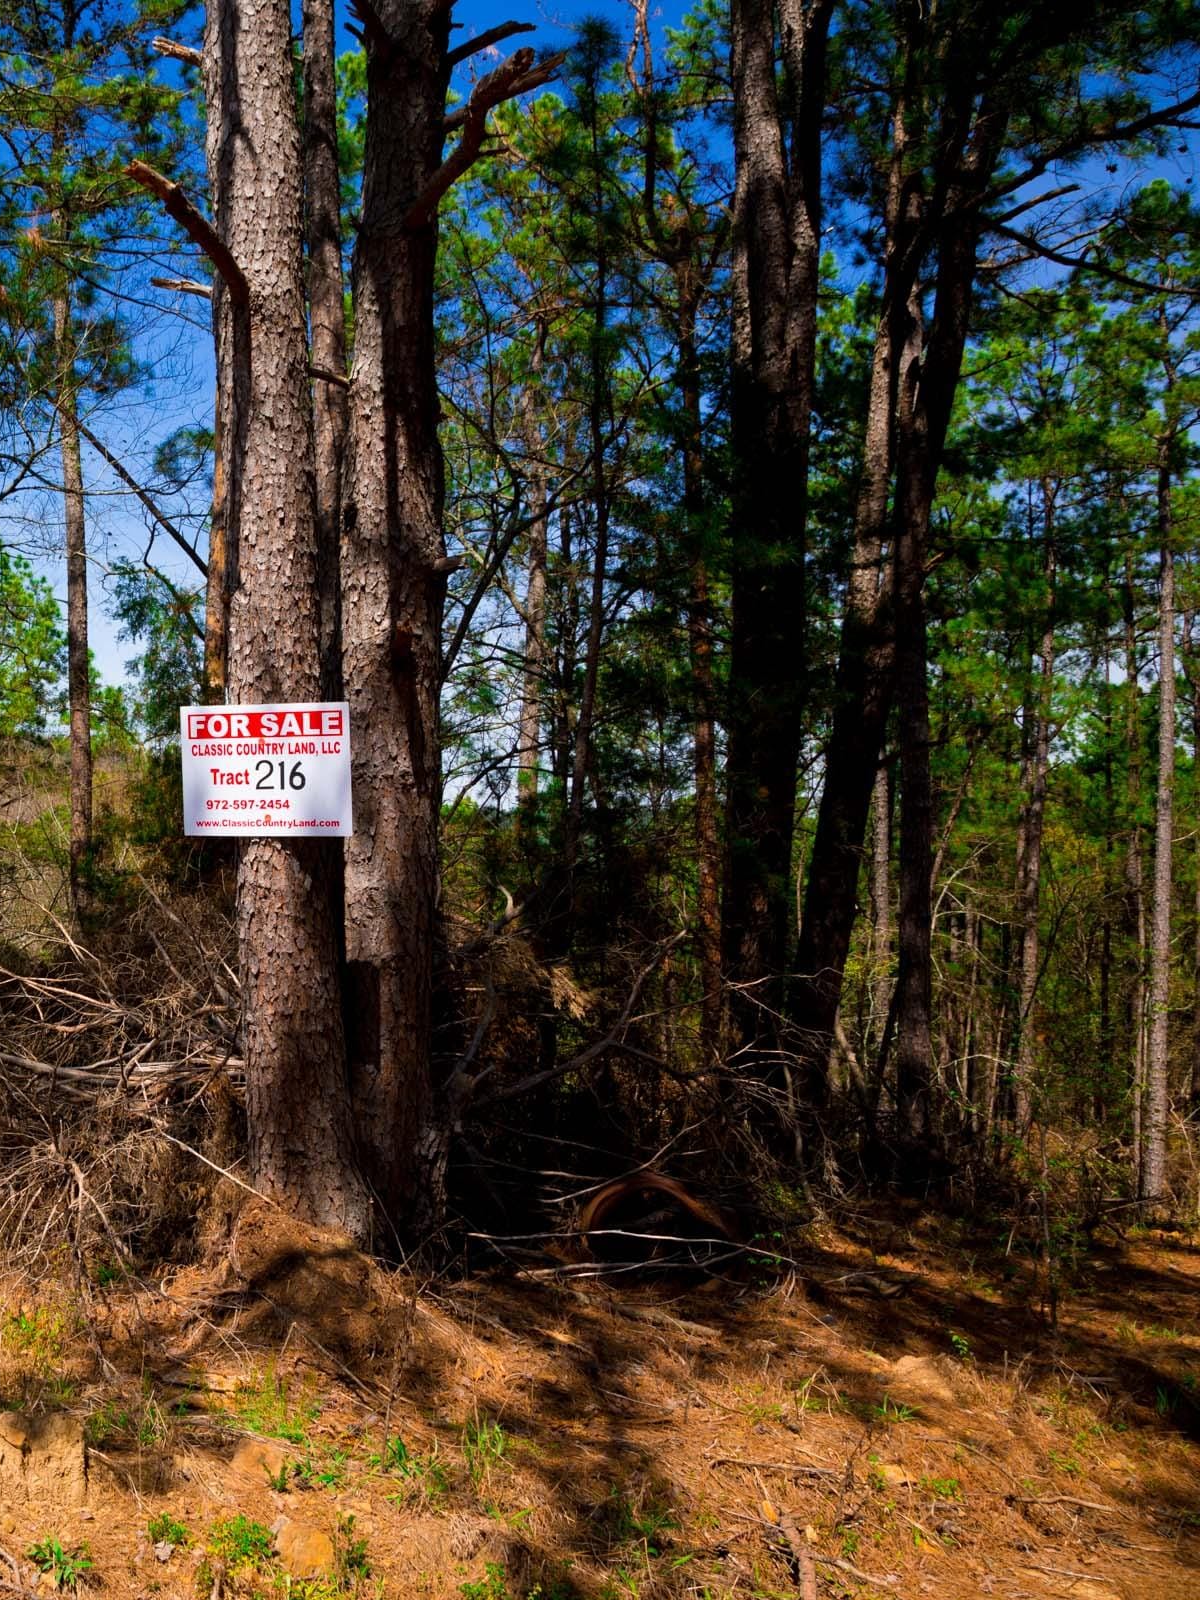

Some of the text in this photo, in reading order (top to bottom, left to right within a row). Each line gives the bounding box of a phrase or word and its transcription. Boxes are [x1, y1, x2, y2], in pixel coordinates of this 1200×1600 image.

[189, 712, 341, 738] FOR SALE
[191, 741, 341, 757] CLASSIC COUNTRY LAND, LLC
[210, 759, 306, 791] Tract 216
[206, 799, 290, 810] 972-597-2454
[196, 818, 340, 829] www.ClassicCountryLand.com
